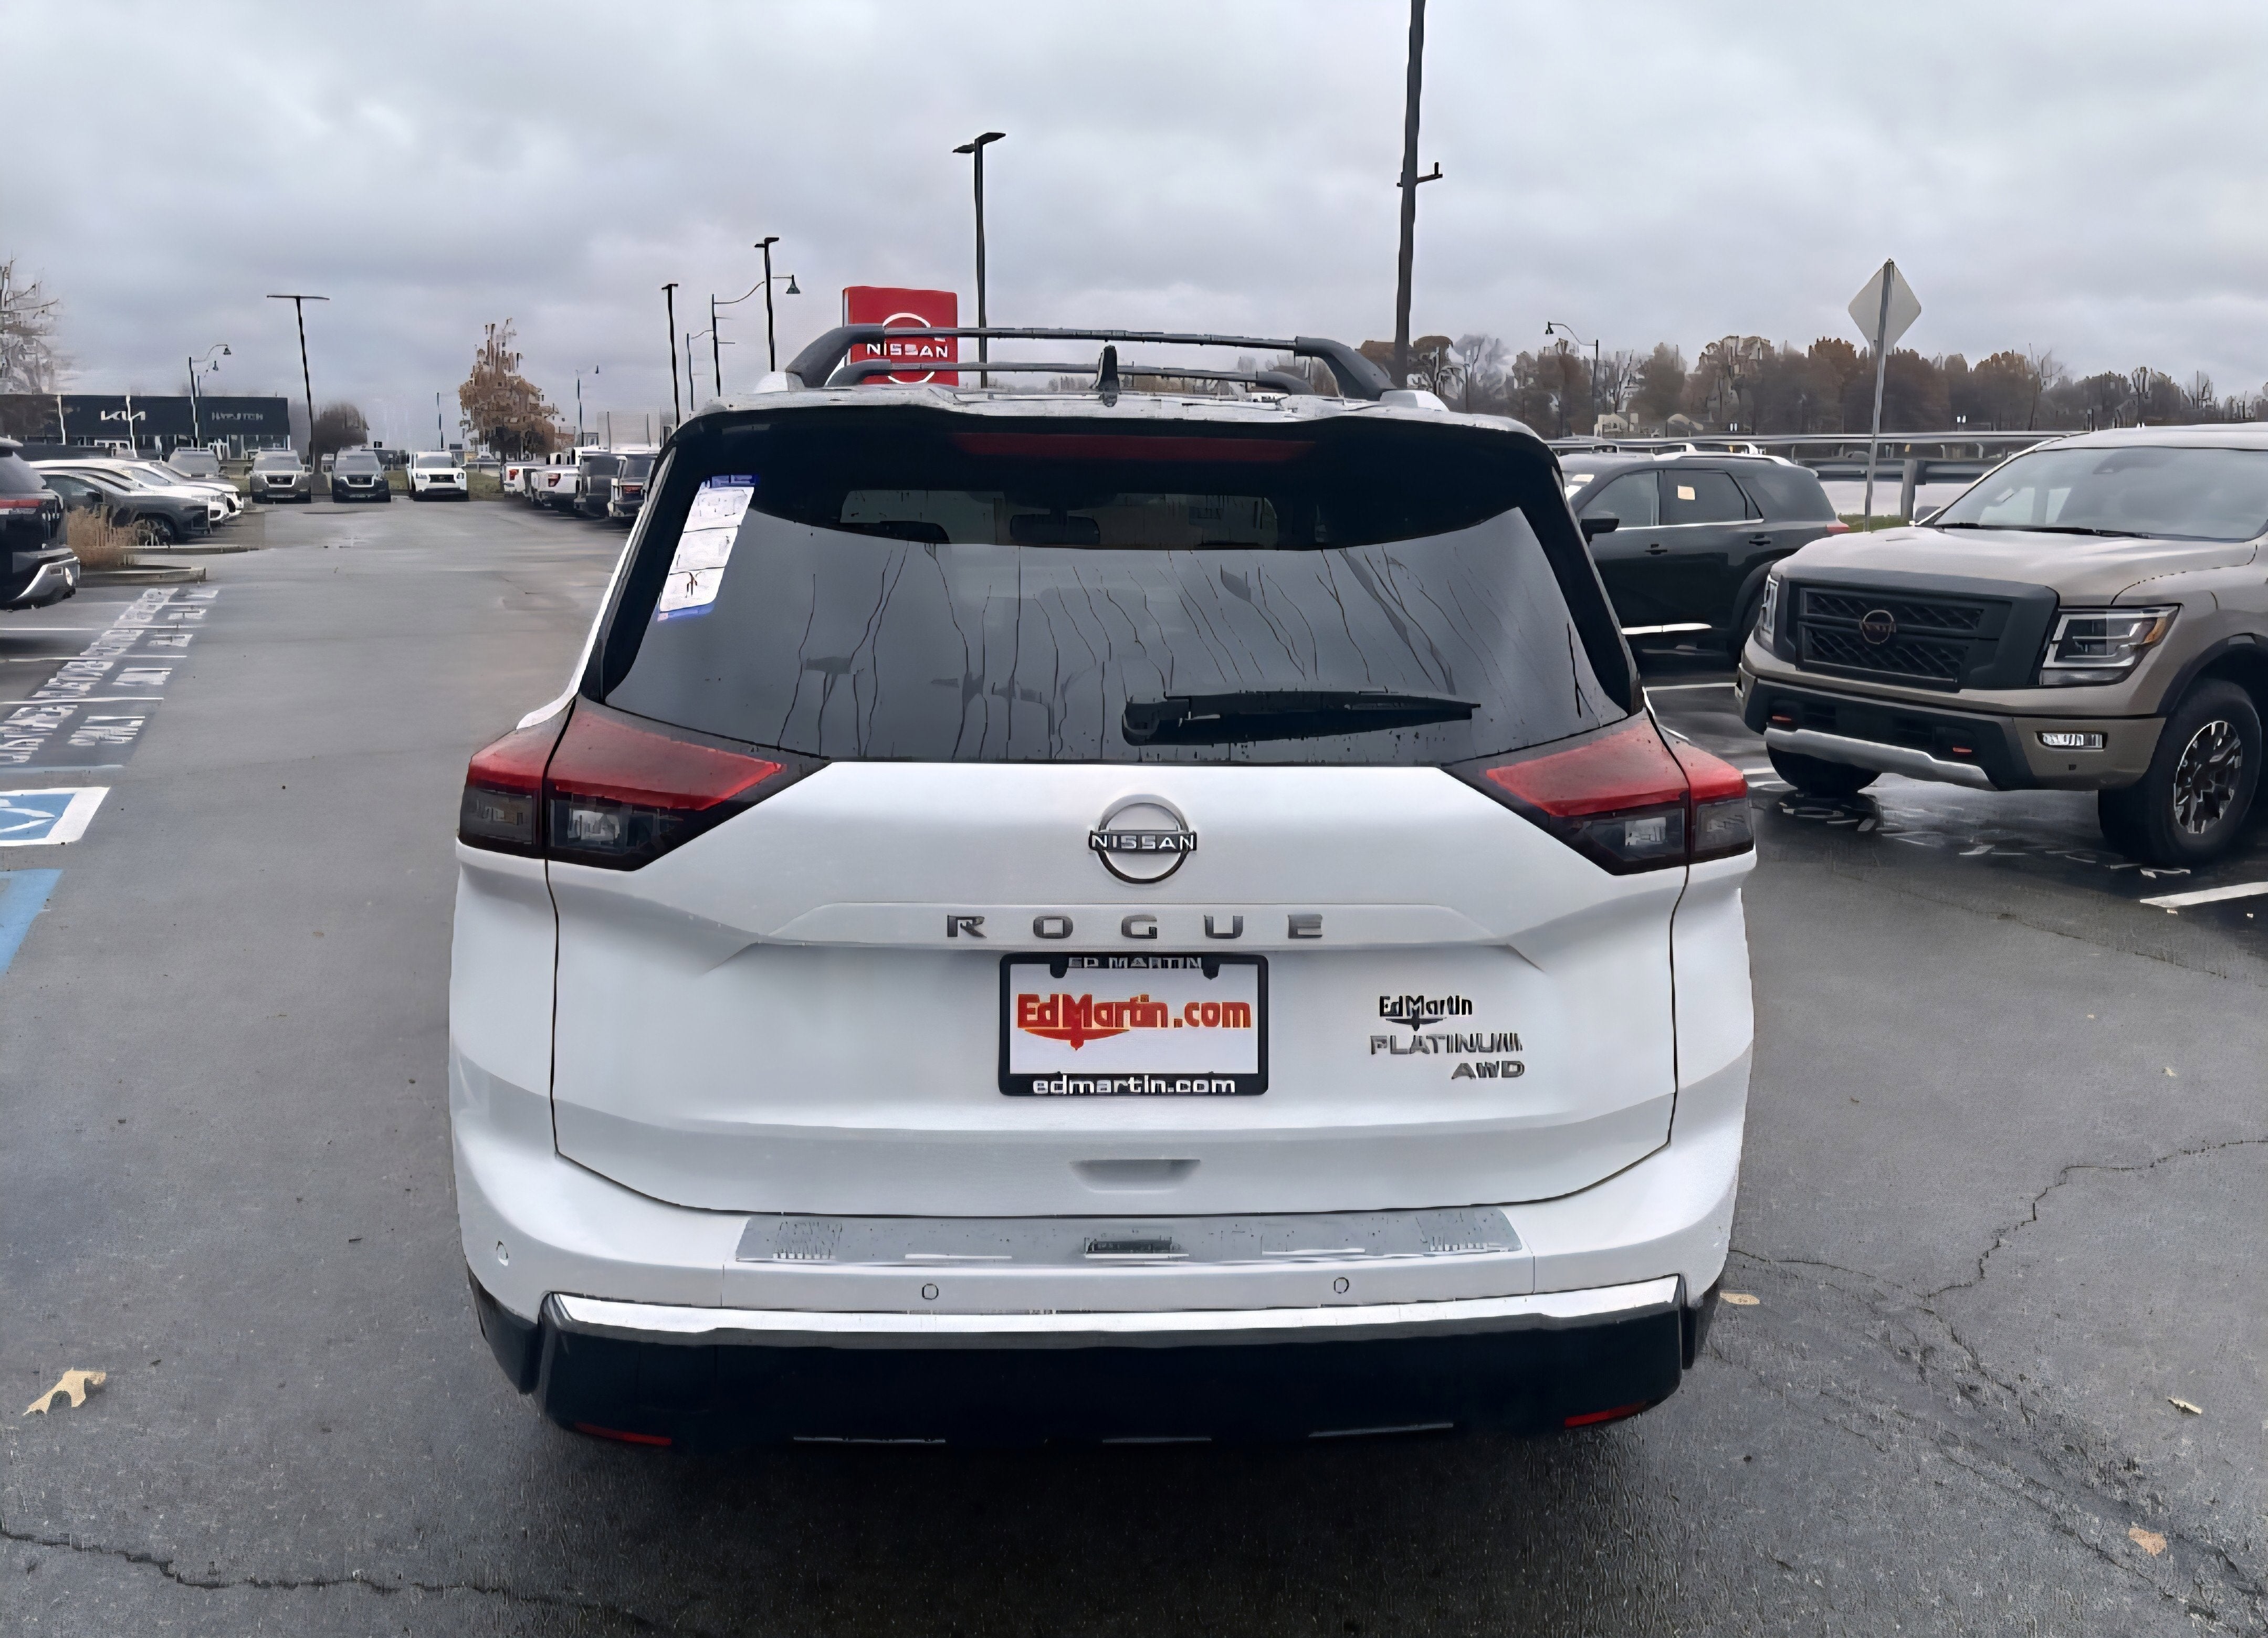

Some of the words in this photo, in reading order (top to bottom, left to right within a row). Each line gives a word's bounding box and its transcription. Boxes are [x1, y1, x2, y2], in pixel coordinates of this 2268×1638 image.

[867, 343, 948, 358] NISSAN
[1091, 834, 1194, 850] NISSAN
[947, 914, 1322, 939] ROGUE
[1370, 1033, 1523, 1055] PLATINUM
[1451, 1061, 1525, 1079] AWD
[1033, 1075, 1235, 1094] edmartin.com
